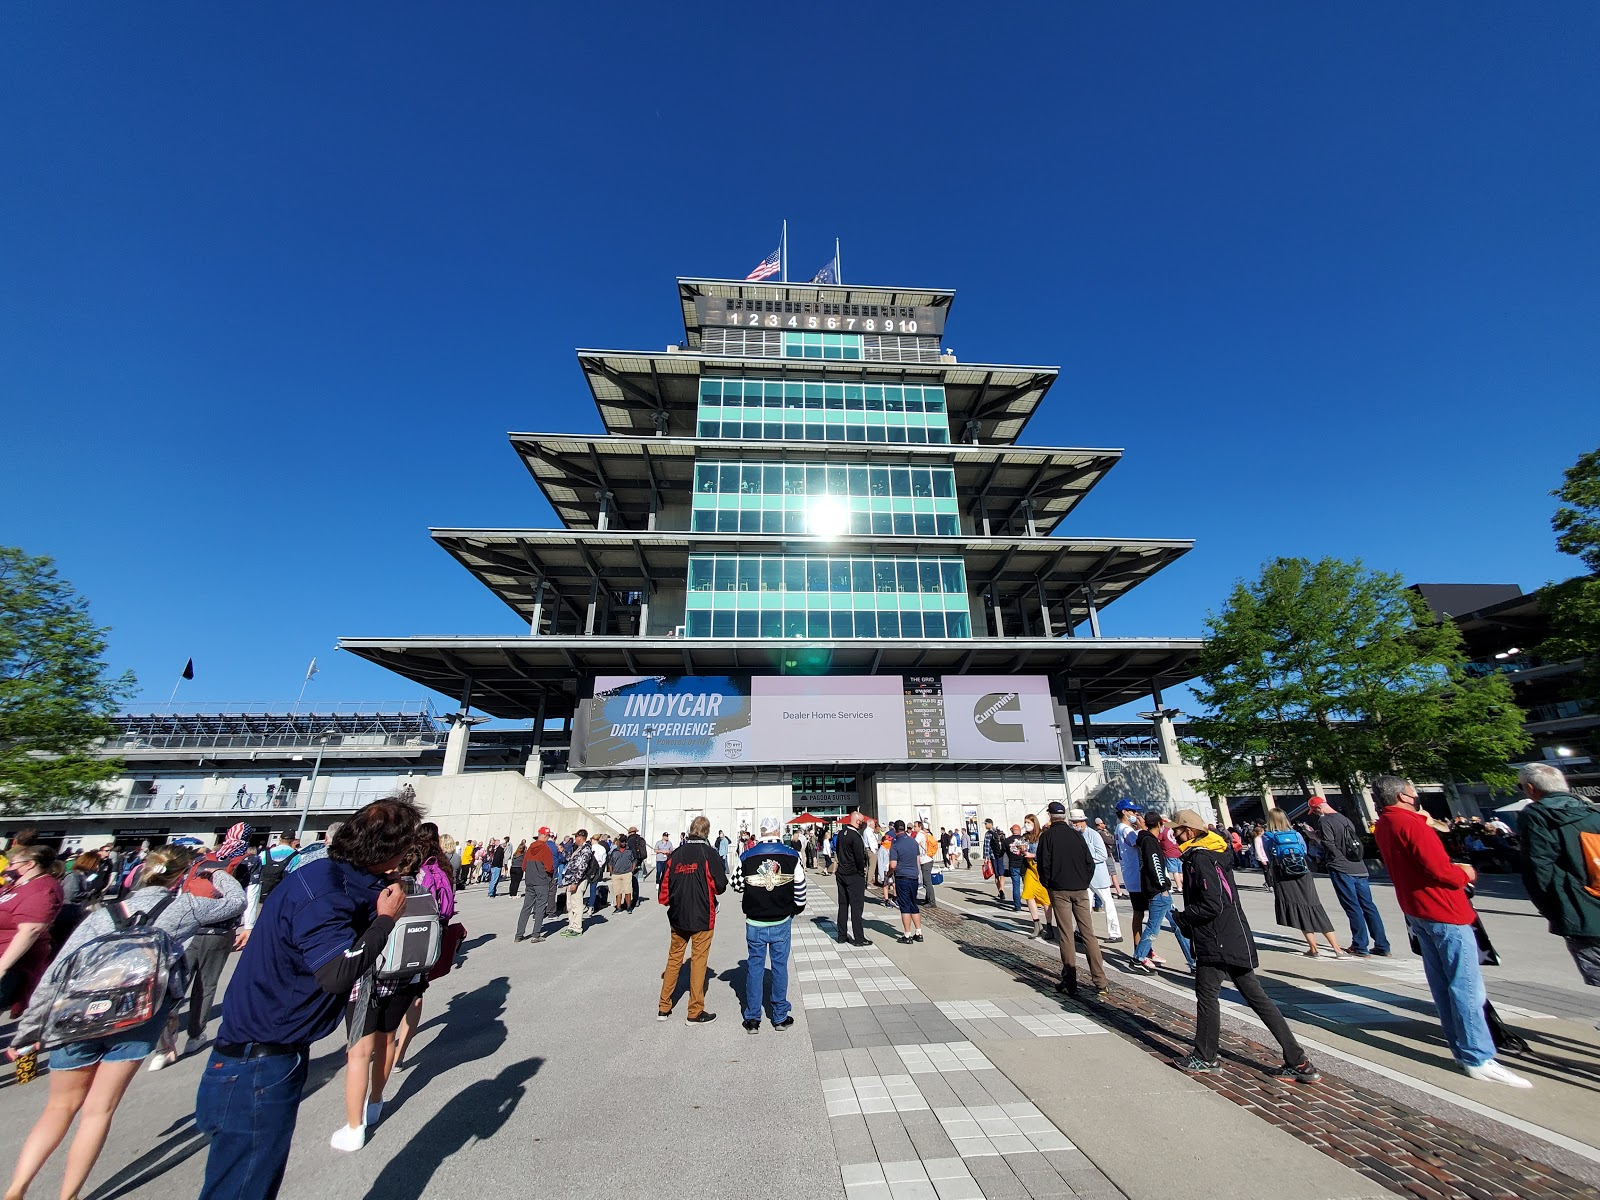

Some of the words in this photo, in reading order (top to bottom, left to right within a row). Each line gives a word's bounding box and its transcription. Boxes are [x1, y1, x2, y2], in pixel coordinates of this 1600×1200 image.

[731, 313, 738, 324] 1
[749, 313, 759, 326] 2
[769, 314, 778, 326] 3
[788, 315, 798, 327] 4
[808, 316, 817, 328] 5
[827, 317, 836, 329] 6
[846, 318, 856, 330] 7
[866, 319, 875, 331] 8
[885, 320, 894, 331] 9
[899, 320, 917, 333] 10
[624, 693, 723, 717] INDYCAR
[974, 692, 1016, 725] Cummins
[783, 711, 810, 720] Dealer
[811, 711, 837, 719] Home
[838, 710, 874, 719] Services
[610, 723, 640, 737] DATA
[641, 722, 717, 737] EXPERIENCE
[656, 738, 686, 746] Powered
[407, 926, 428, 934] IGLOO
